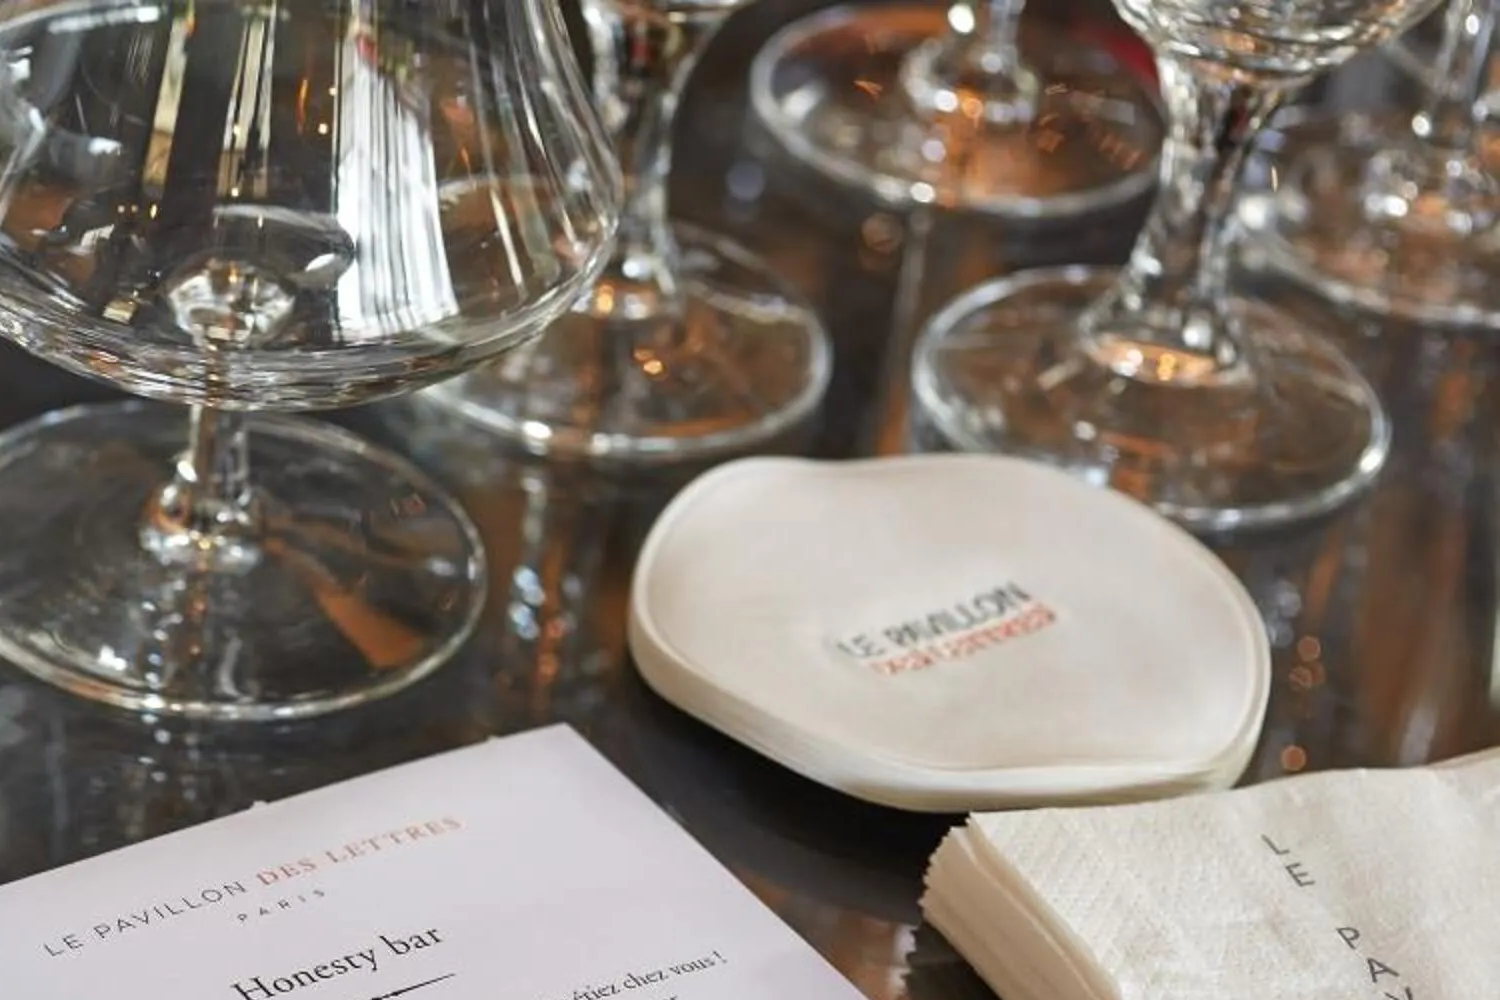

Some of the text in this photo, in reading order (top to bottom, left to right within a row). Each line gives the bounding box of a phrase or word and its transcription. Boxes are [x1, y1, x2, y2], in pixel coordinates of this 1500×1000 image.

[1261, 833, 1316, 888] LE
[43, 816, 463, 959] LE PAVILLON DES LETTRES
[236, 887, 327, 923] PARIS
[380, 925, 446, 956] bar
[623, 972, 669, 990] chez
[669, 955, 716, 977] vous
